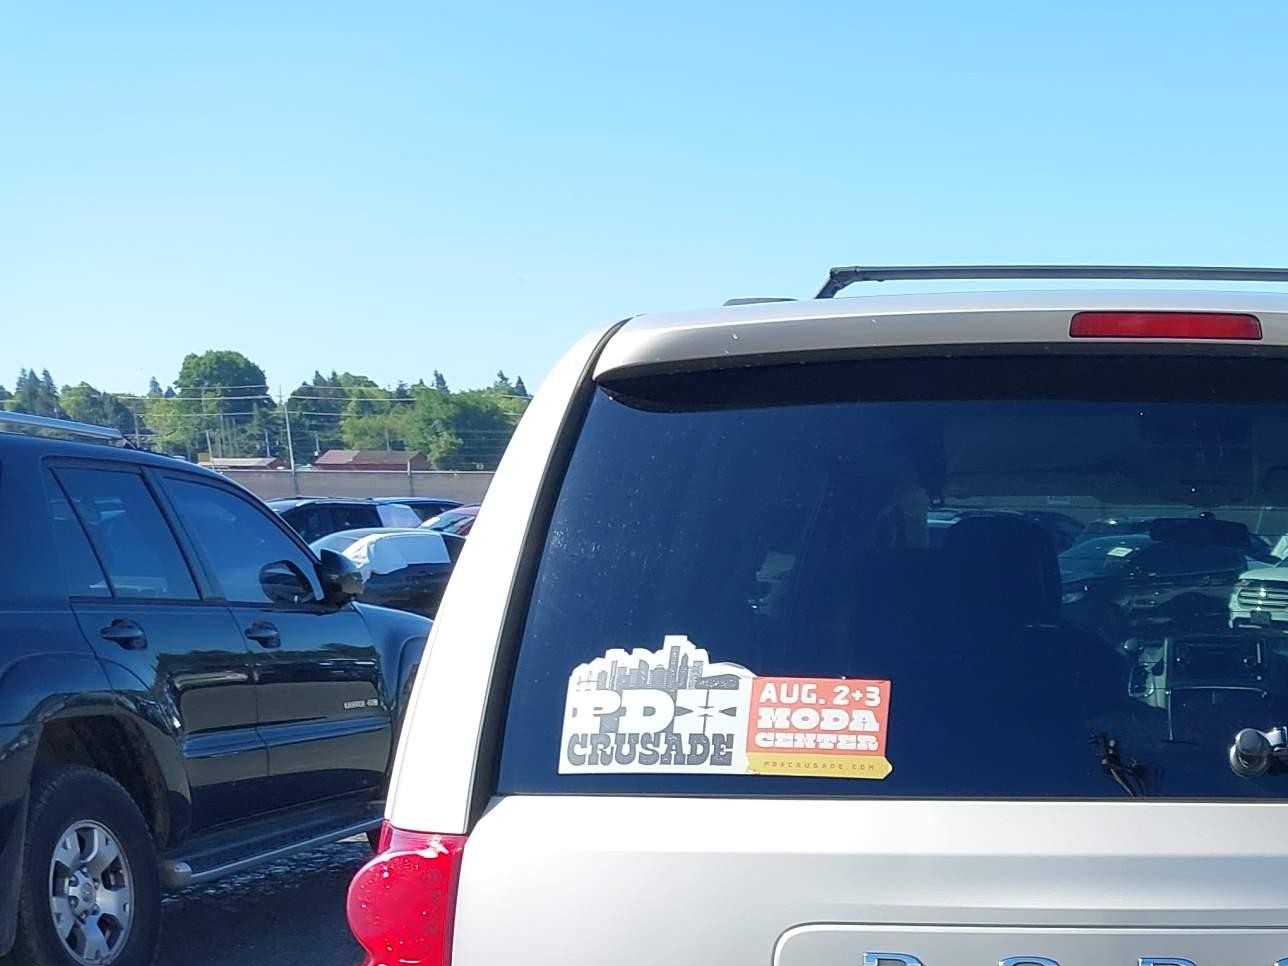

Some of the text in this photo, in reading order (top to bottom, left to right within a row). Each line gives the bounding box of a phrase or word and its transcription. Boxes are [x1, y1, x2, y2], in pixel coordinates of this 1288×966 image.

[759, 683, 881, 707] AUG. 2+3
[571, 689, 740, 735] PDX
[756, 707, 879, 732] MODA
[567, 733, 733, 766] CRUSADE
[754, 732, 879, 751] CENTER
